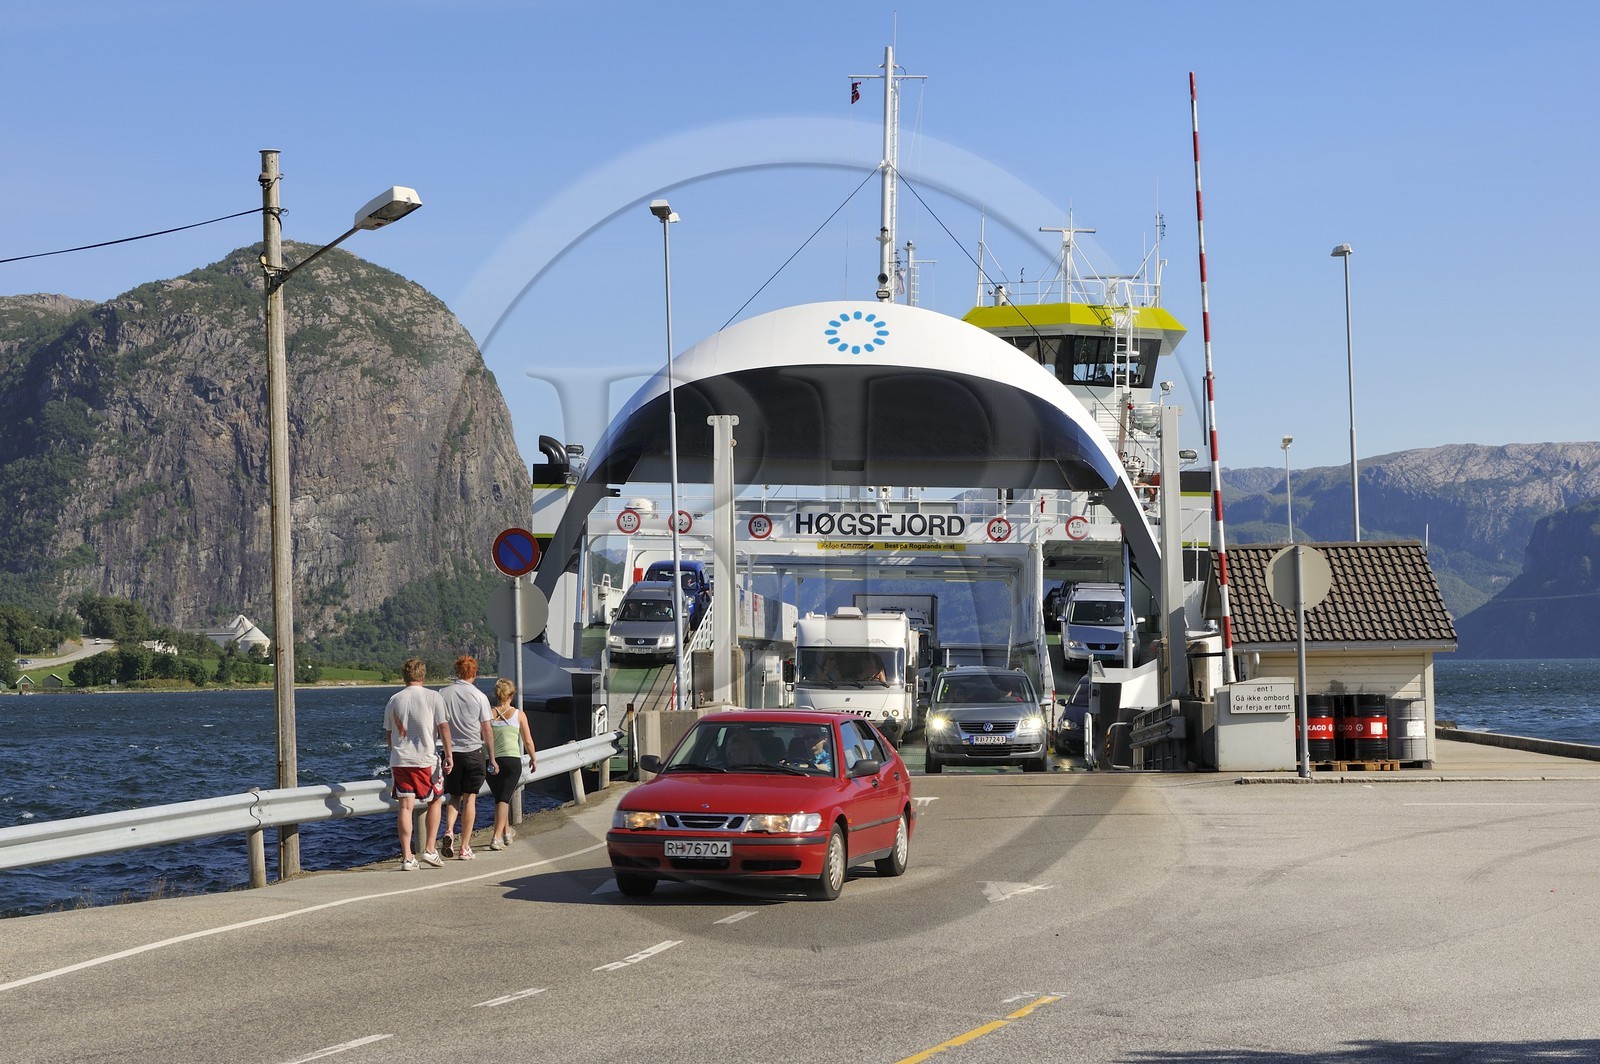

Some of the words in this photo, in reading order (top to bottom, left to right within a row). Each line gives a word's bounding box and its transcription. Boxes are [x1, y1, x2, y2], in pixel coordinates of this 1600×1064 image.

[795, 514, 966, 536] HØGSFJORD
[909, 543, 942, 551] Rogalands
[1235, 694, 1245, 702] Gå
[1246, 694, 1261, 702] ikke
[1245, 704, 1263, 712] ferja
